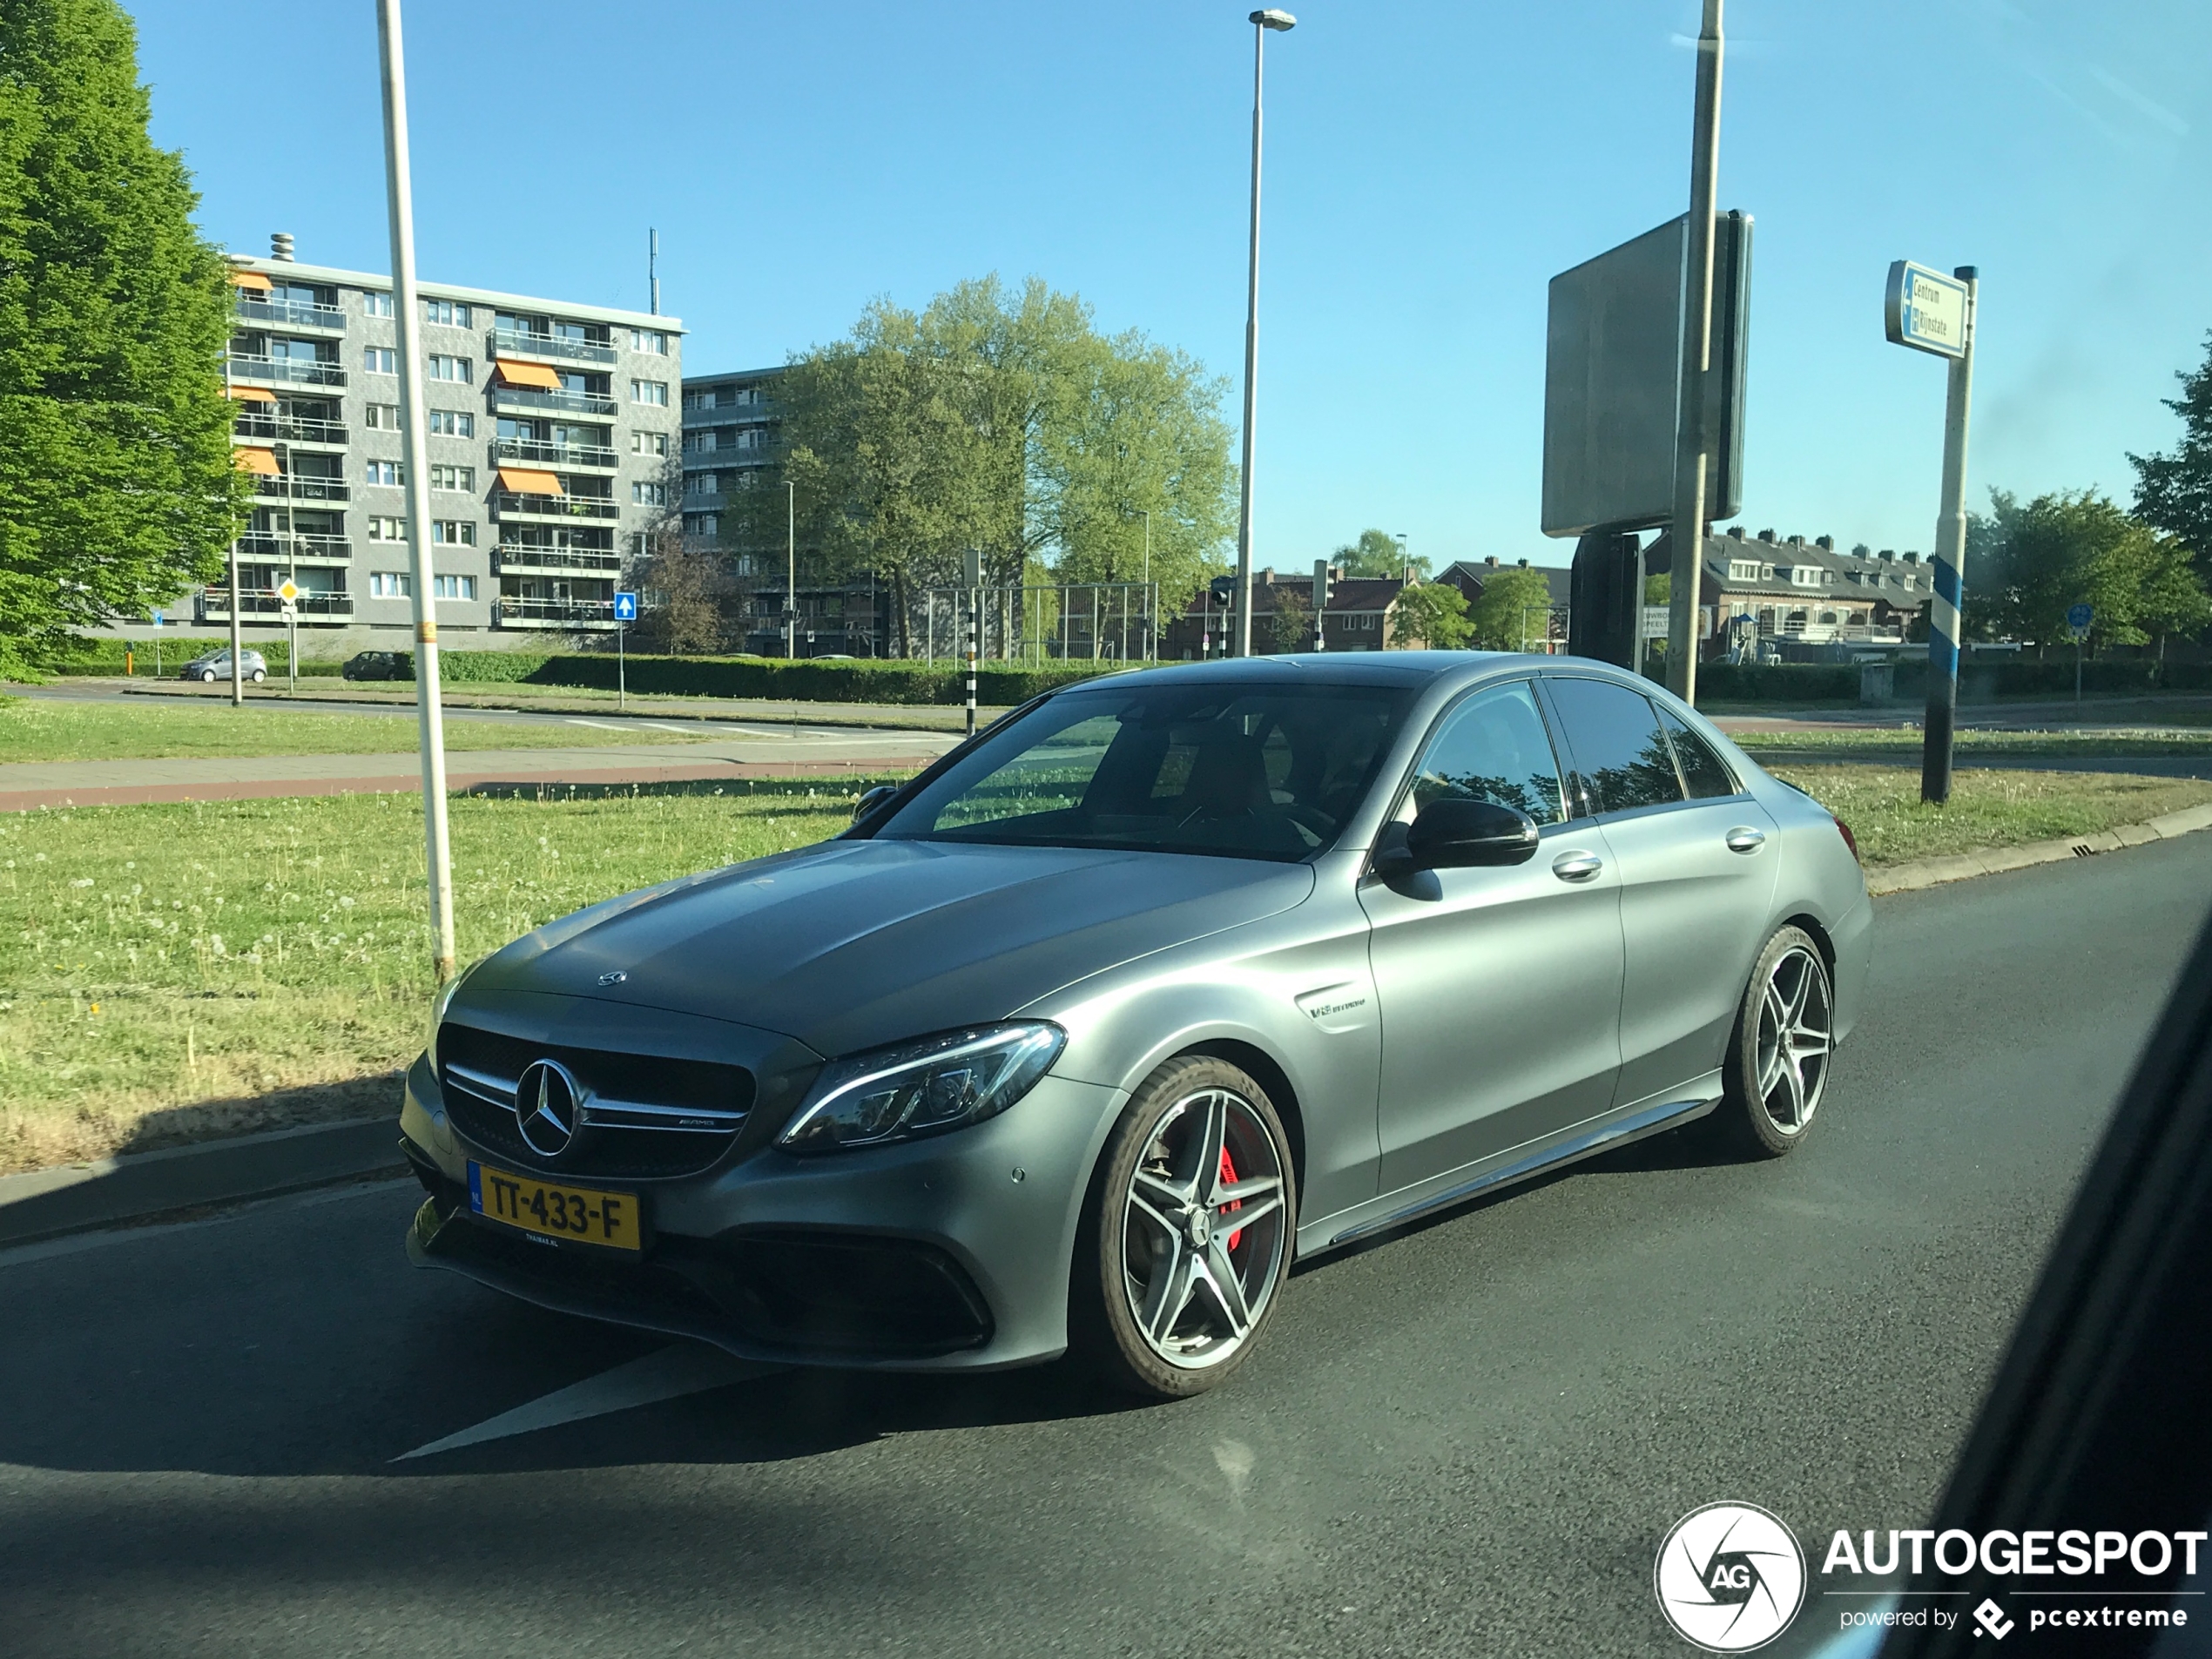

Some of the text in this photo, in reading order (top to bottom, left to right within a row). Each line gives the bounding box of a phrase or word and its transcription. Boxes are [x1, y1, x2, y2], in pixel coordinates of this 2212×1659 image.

[1914, 279, 1939, 304] Centrum
[1919, 310, 1946, 336] Rijnstate
[1310, 1004, 1332, 1018] V8
[472, 1192, 482, 1205] NL
[490, 1176, 621, 1238] TT-433-F
